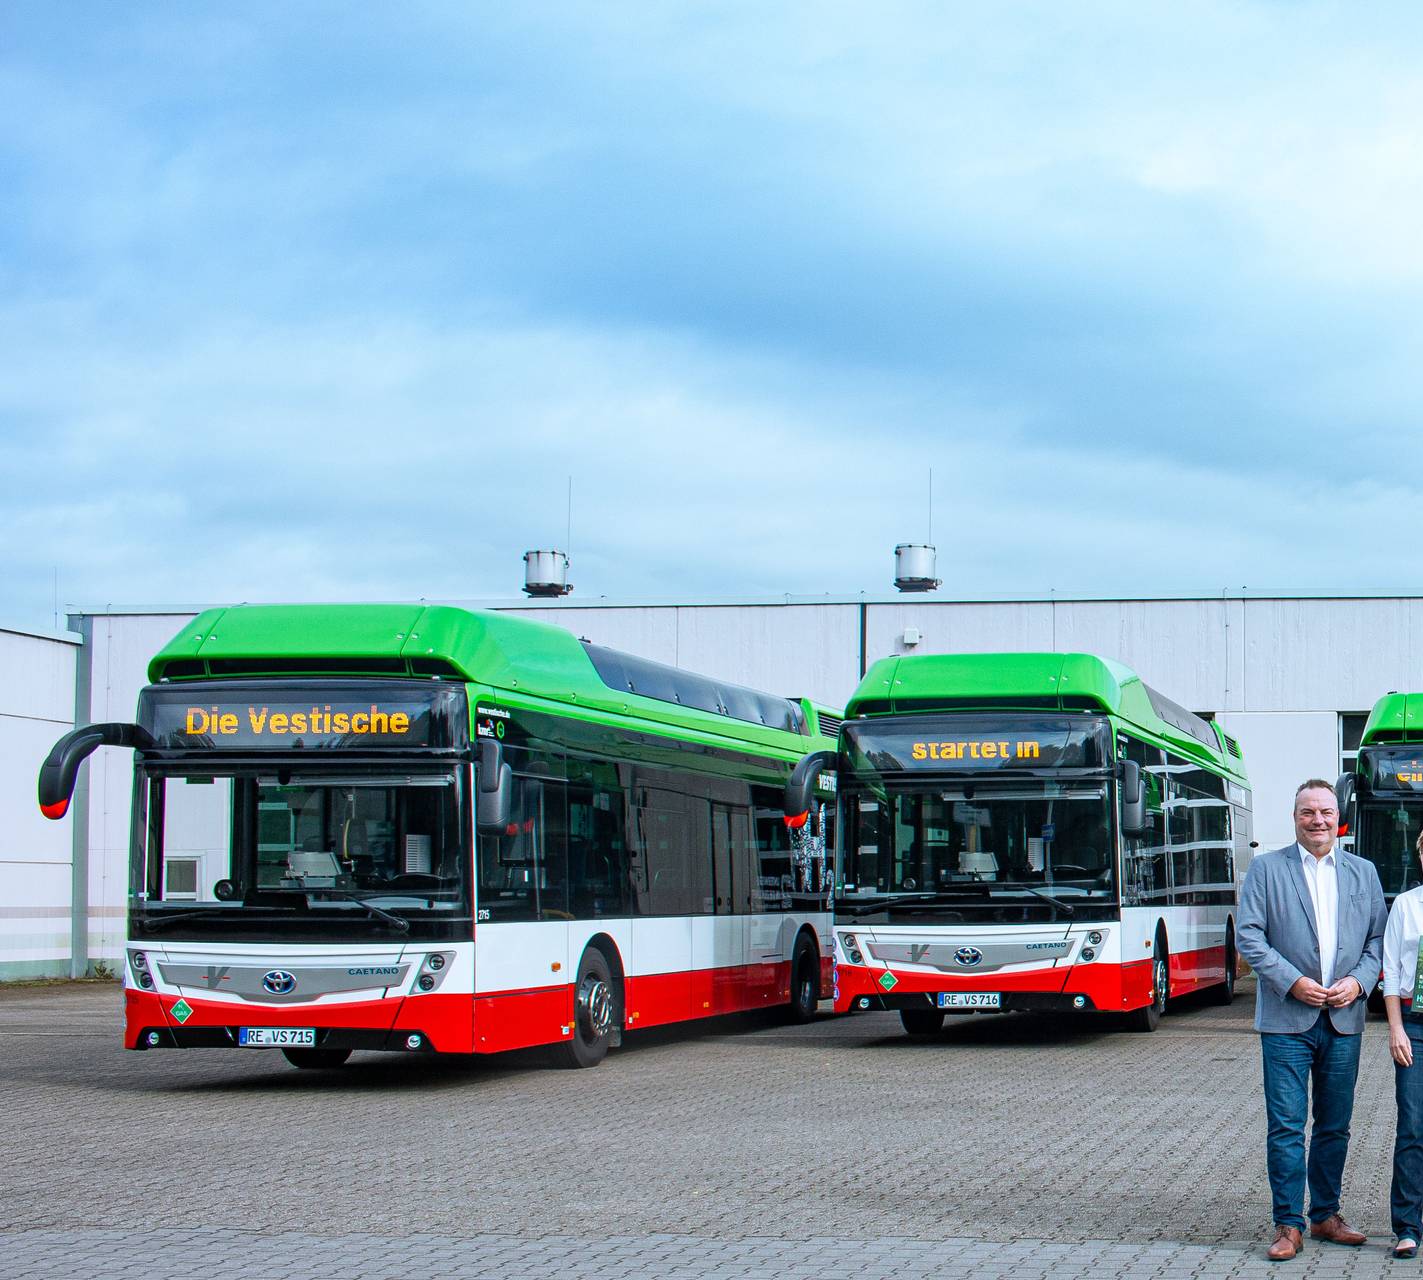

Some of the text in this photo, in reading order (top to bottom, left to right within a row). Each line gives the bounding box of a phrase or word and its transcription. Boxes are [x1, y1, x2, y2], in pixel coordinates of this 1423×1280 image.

[186, 704, 409, 734] Die Vestische
[1026, 942, 1067, 950] CAETANO
[348, 967, 400, 976] CAETANO
[944, 994, 957, 1005] RE
[247, 1030, 263, 1043] RE
